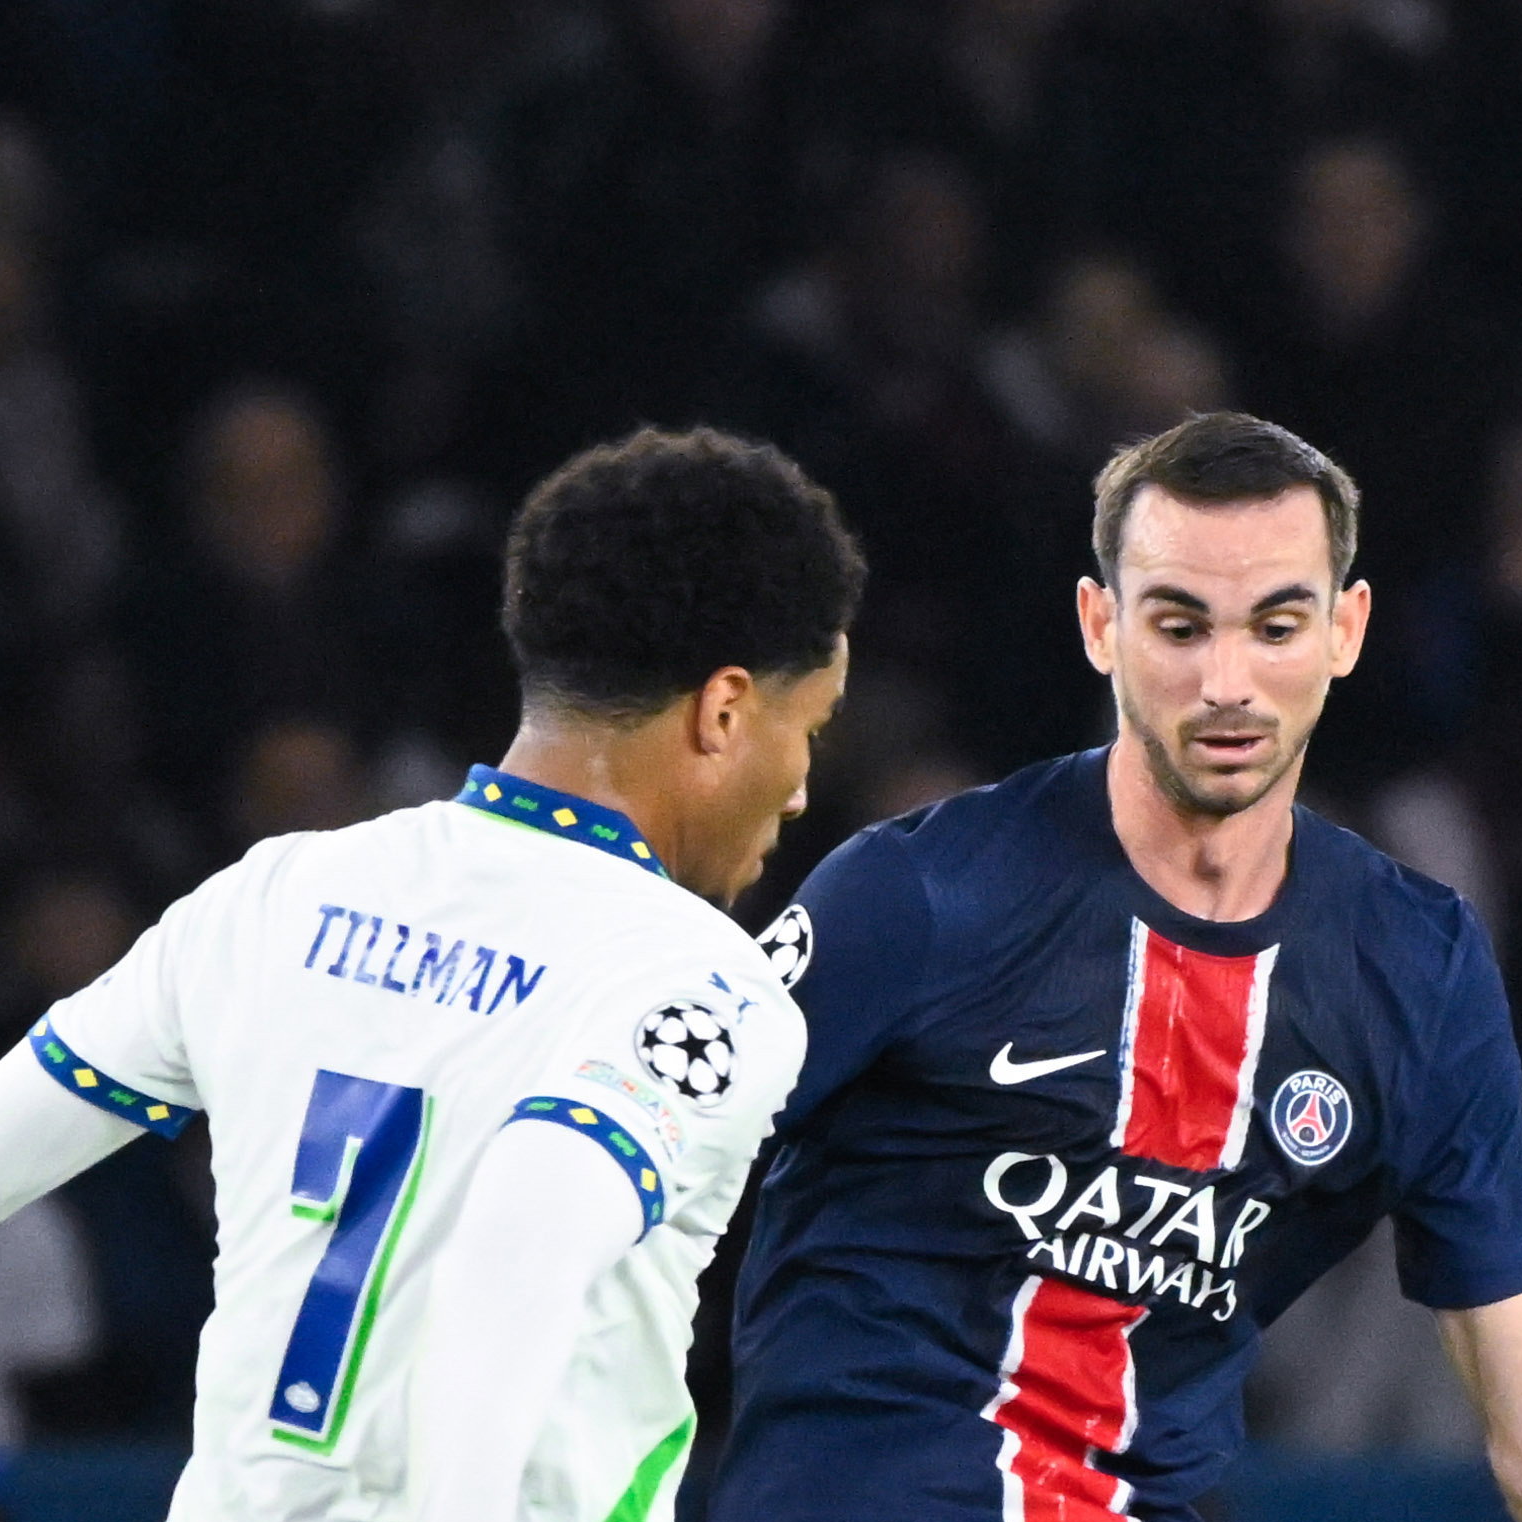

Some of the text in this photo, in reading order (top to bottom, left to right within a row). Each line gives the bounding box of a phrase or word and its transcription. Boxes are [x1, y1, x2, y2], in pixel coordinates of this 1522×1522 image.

[304, 903, 547, 1015] TILLMAN
[1289, 1075, 1344, 1105] PARIS
[269, 1068, 433, 1456] 7
[983, 1151, 1271, 1268] QATAR
[1027, 1232, 1237, 1321] AIRWAYS
